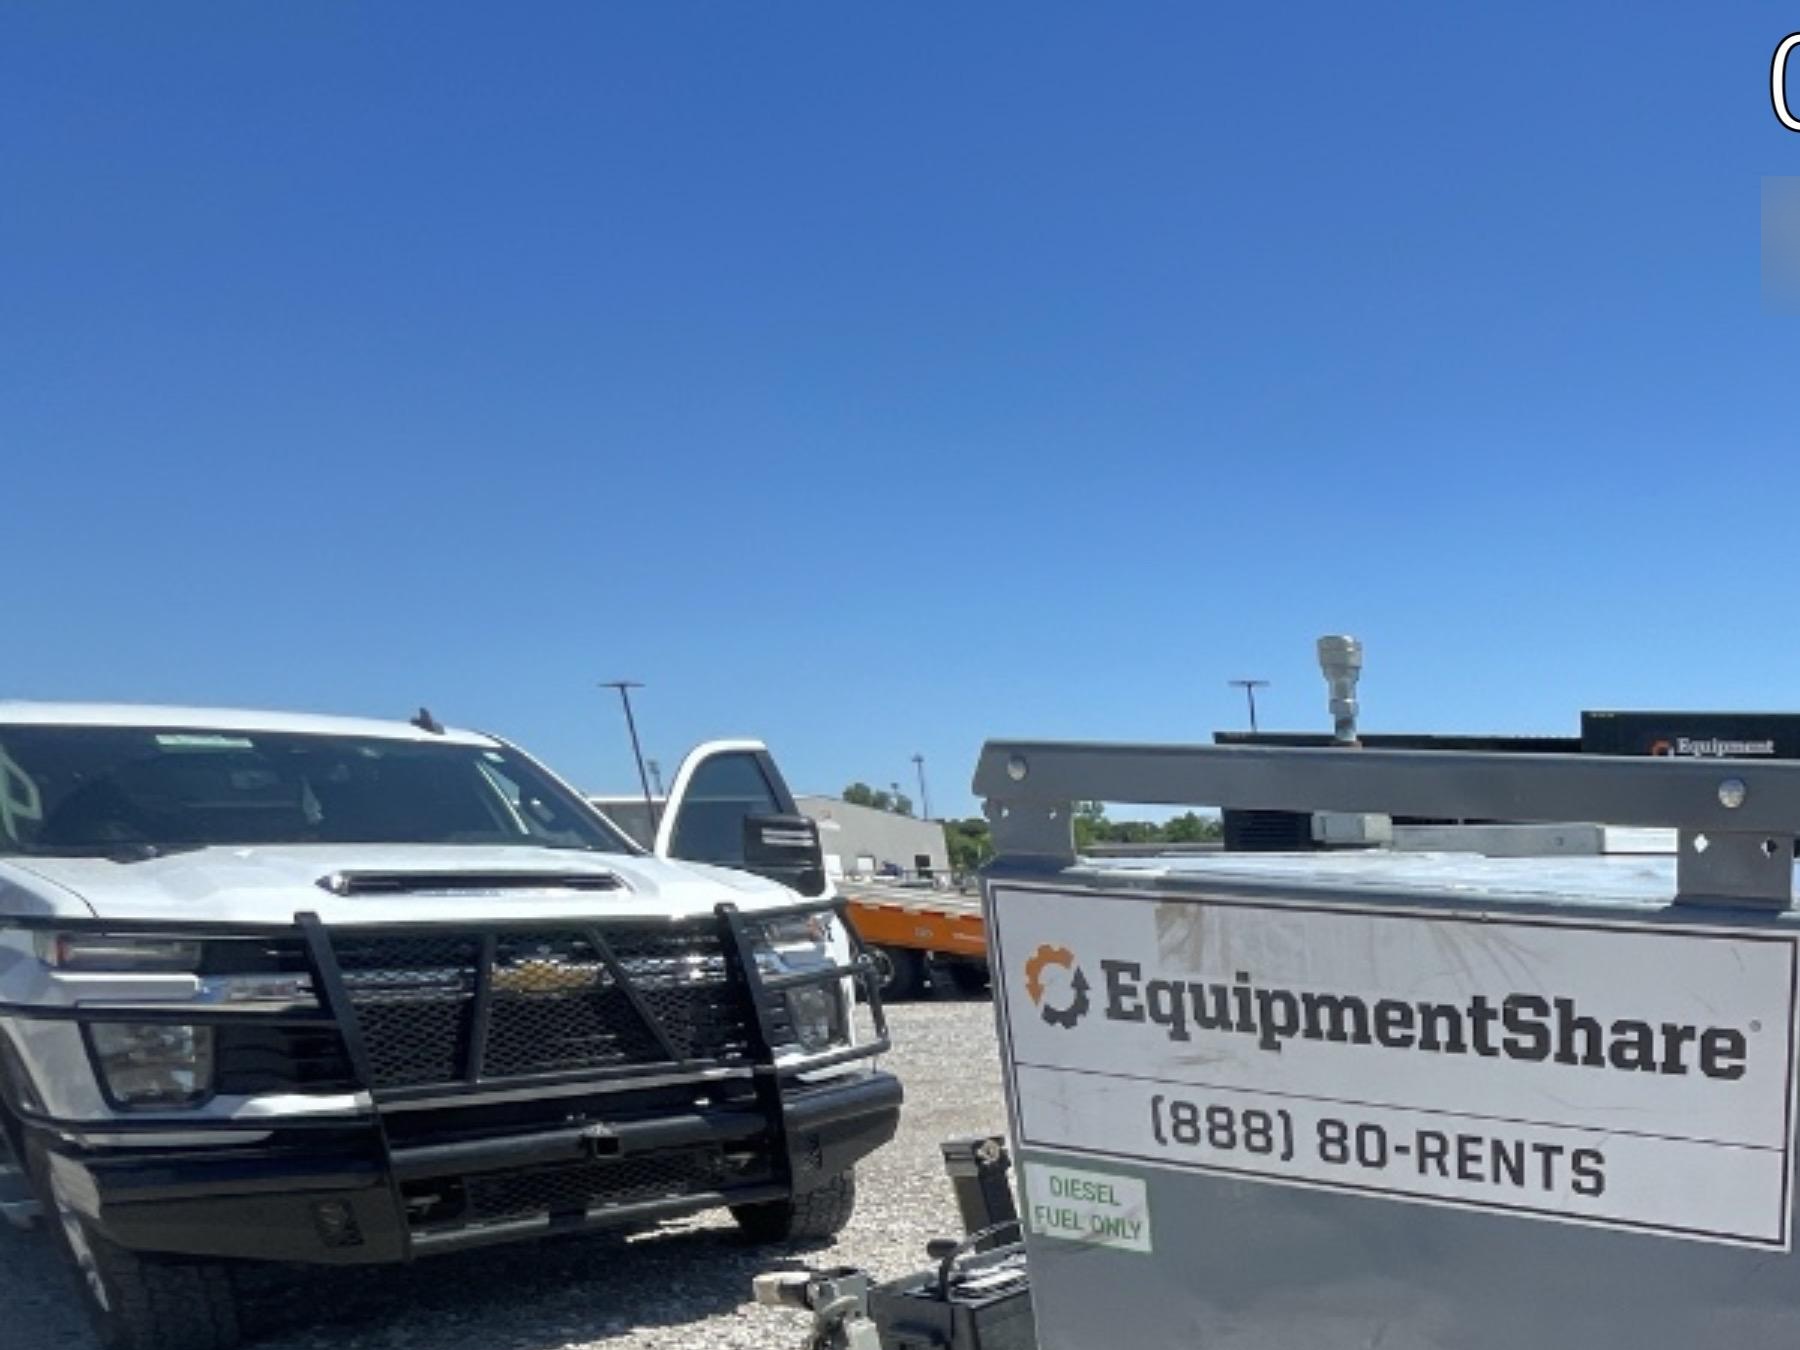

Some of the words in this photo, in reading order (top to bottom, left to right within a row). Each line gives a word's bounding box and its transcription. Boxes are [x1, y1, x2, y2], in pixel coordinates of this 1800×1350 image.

[1101, 959, 1748, 1080] EquipmentShare
[1150, 1094, 1295, 1162] (888)
[1315, 1117, 1606, 1198] 80-RENTS
[1034, 1205, 1084, 1231] FUEL
[1091, 1215, 1142, 1240] ONLY
[1049, 1175, 1122, 1206] DIESEL
